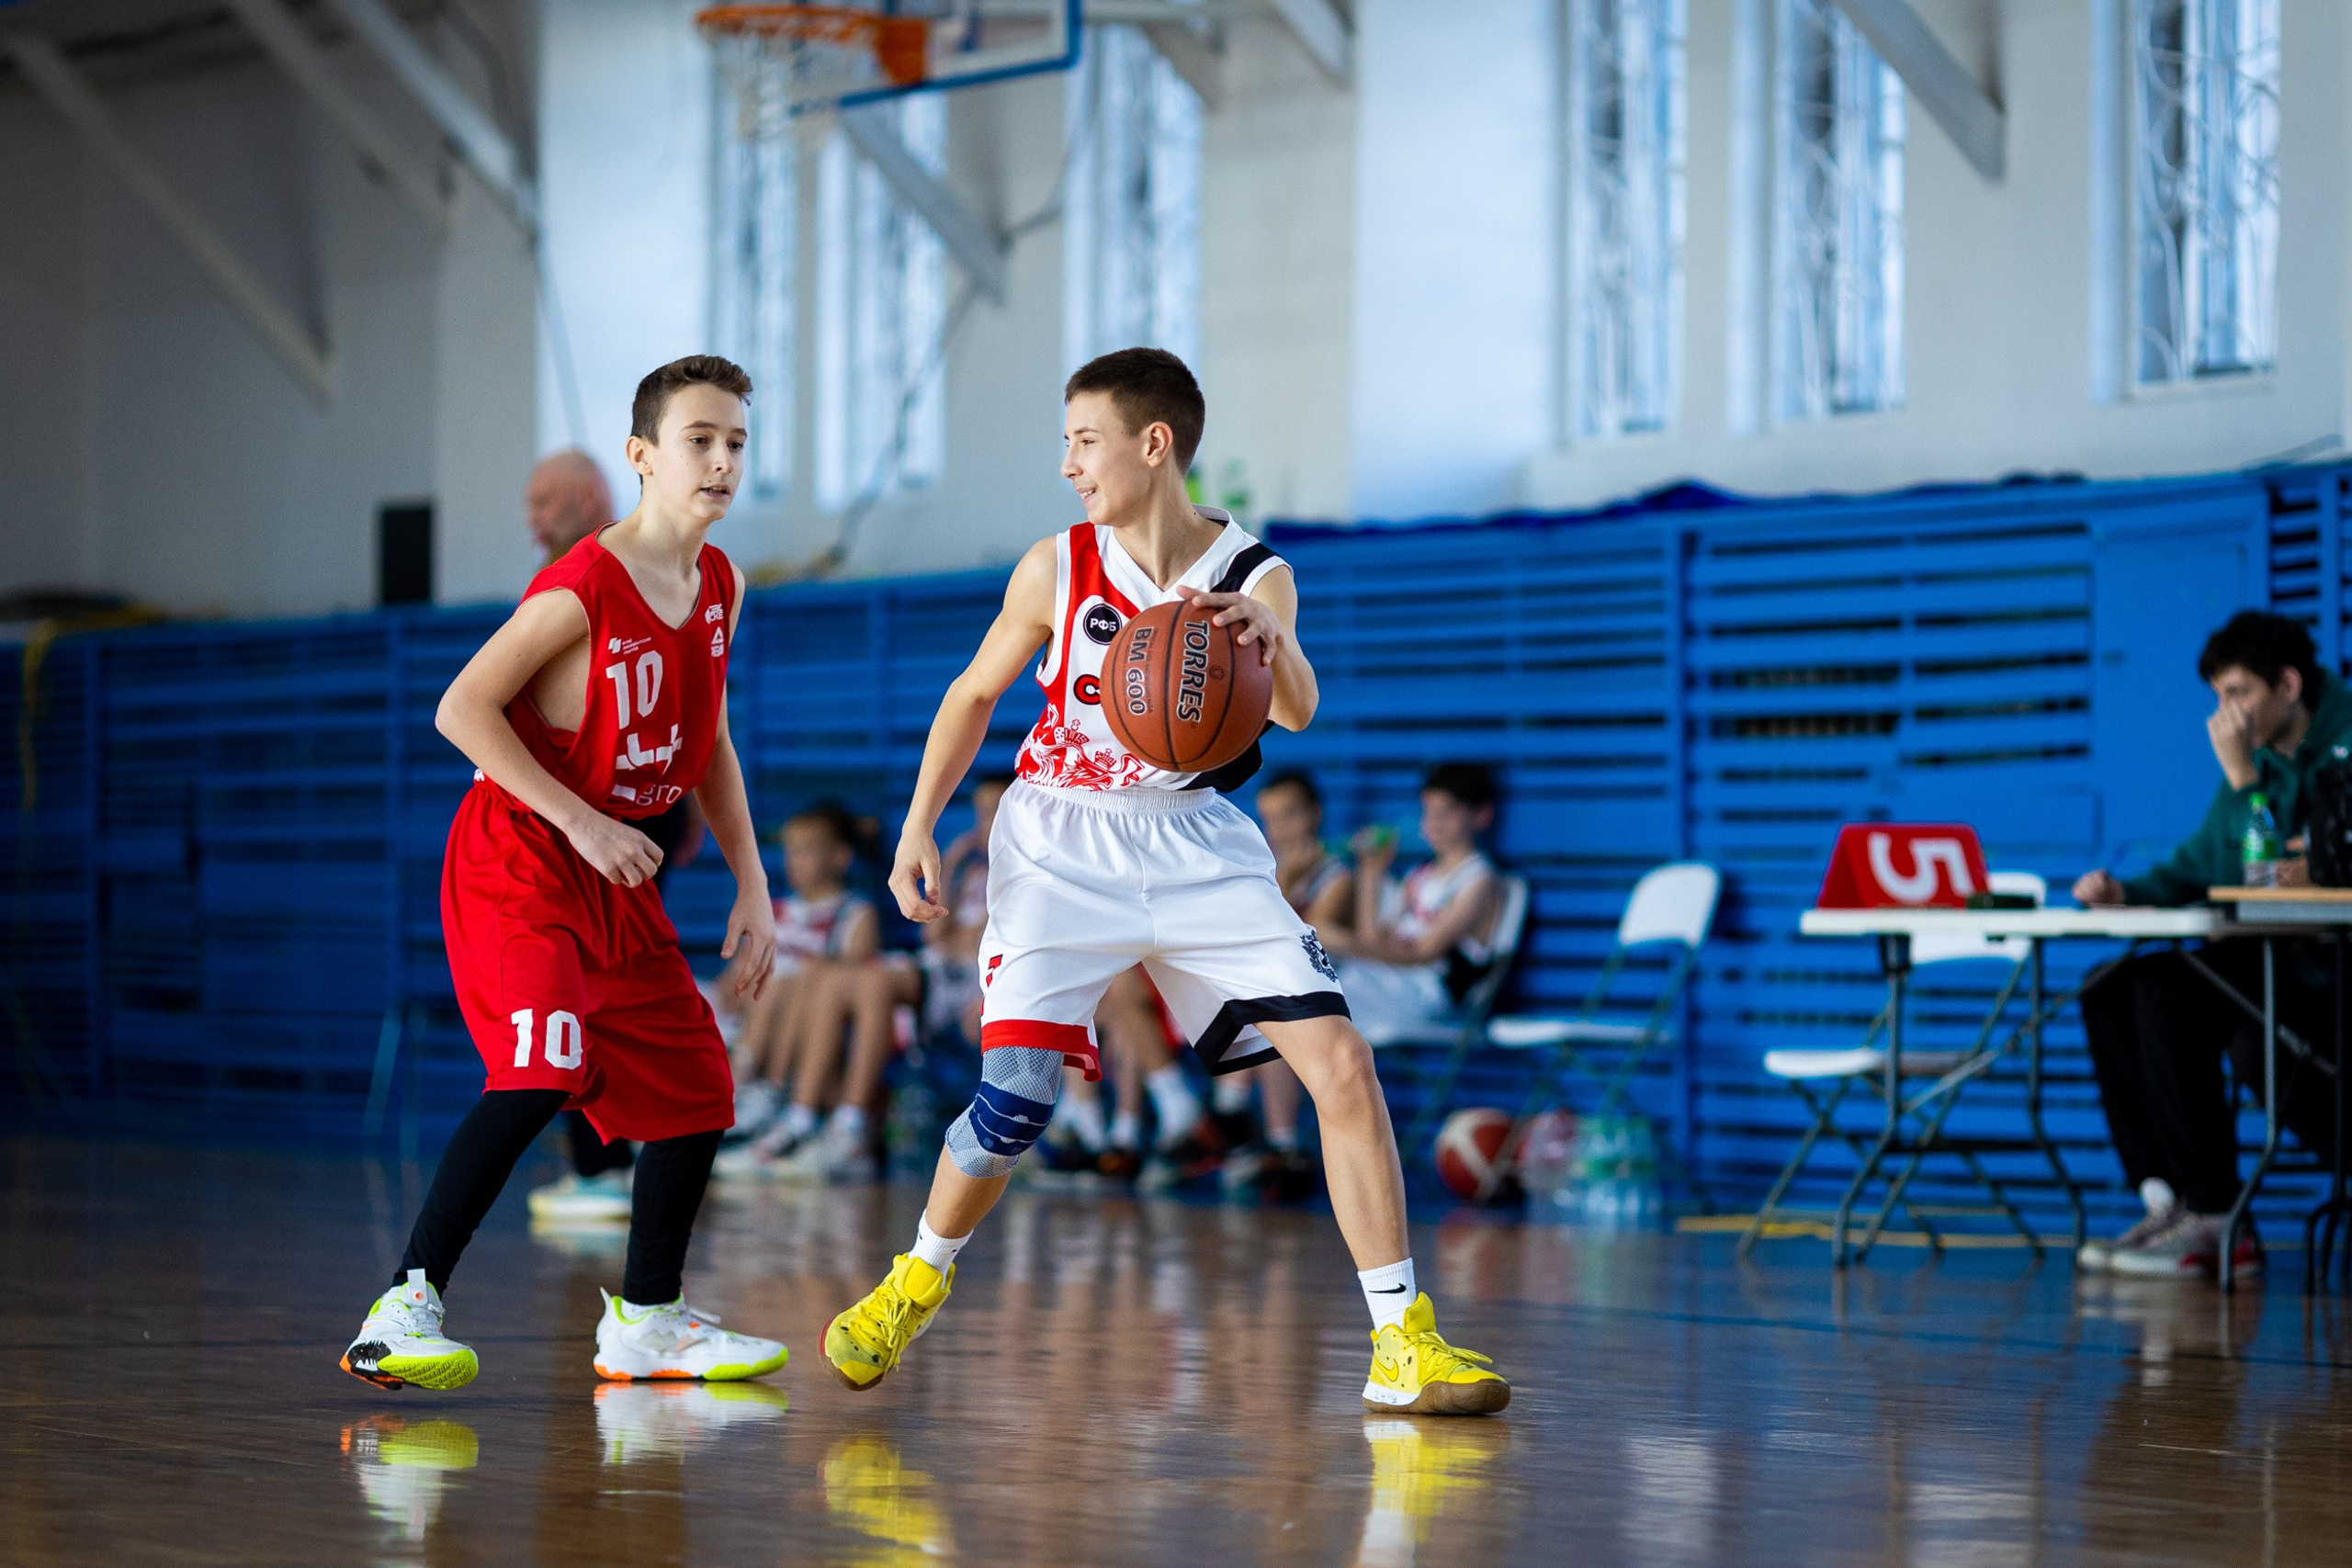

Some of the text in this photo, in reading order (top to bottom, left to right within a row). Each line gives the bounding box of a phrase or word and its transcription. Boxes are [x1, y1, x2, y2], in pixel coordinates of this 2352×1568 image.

[1090, 617, 1117, 632] РФБ
[1127, 626, 1154, 663] BM
[605, 649, 663, 729] 10
[1126, 667, 1148, 716] 600
[1176, 619, 1210, 723] TORRES
[1867, 831, 1975, 903] 5
[511, 1009, 583, 1070] 10
